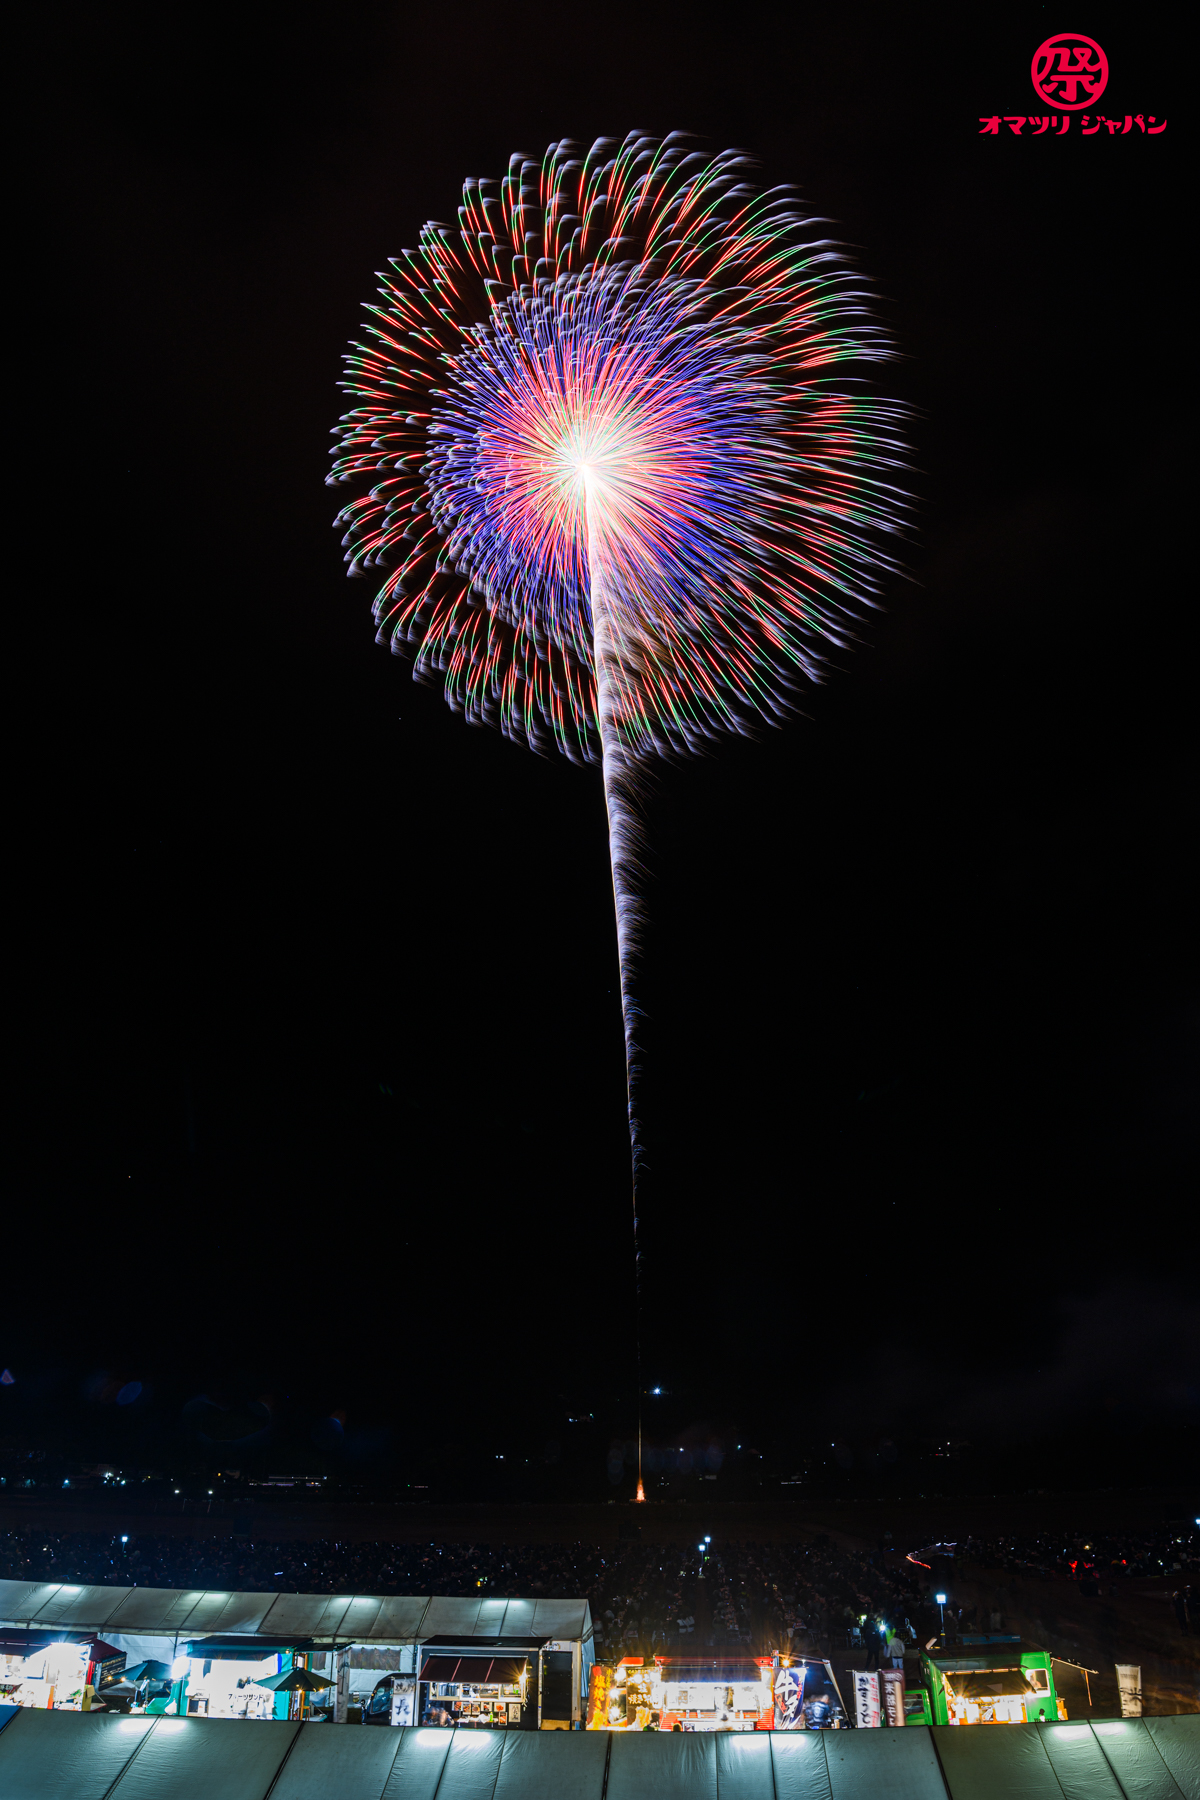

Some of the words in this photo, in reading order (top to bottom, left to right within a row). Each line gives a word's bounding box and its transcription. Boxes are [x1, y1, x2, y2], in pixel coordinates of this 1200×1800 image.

[227, 1693, 264, 1701] フーツサンド
